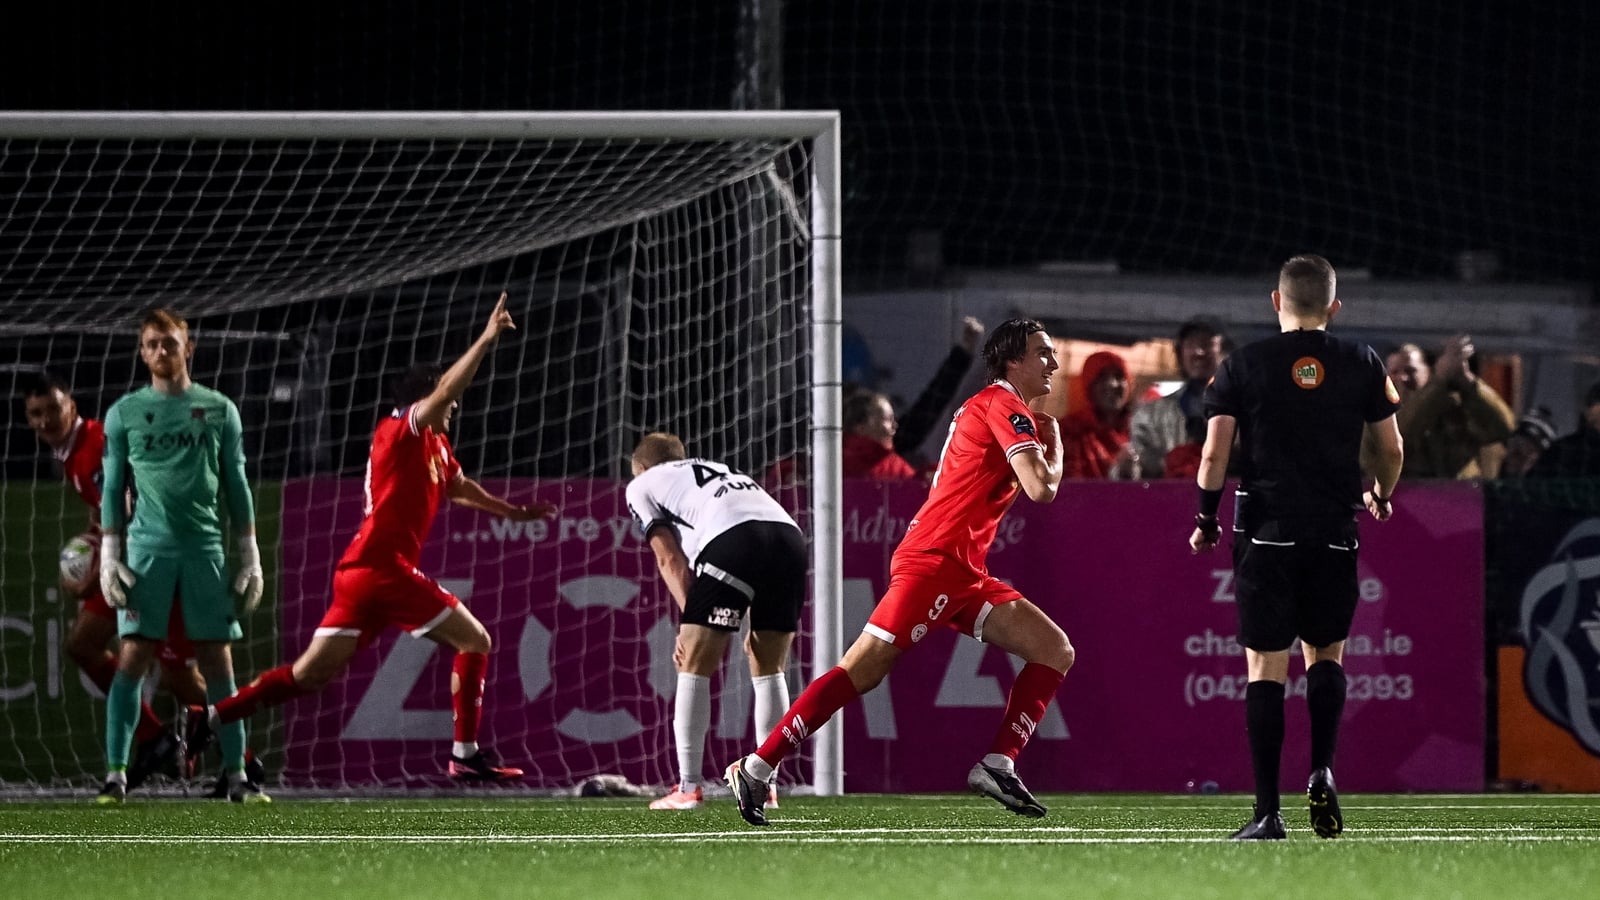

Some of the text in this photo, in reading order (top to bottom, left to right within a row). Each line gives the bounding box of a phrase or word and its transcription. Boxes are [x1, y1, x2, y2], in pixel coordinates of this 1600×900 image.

[142, 430, 209, 450] ZOMA
[608, 516, 648, 549] yo
[844, 509, 1025, 553] Advge
[928, 594, 949, 620] 9
